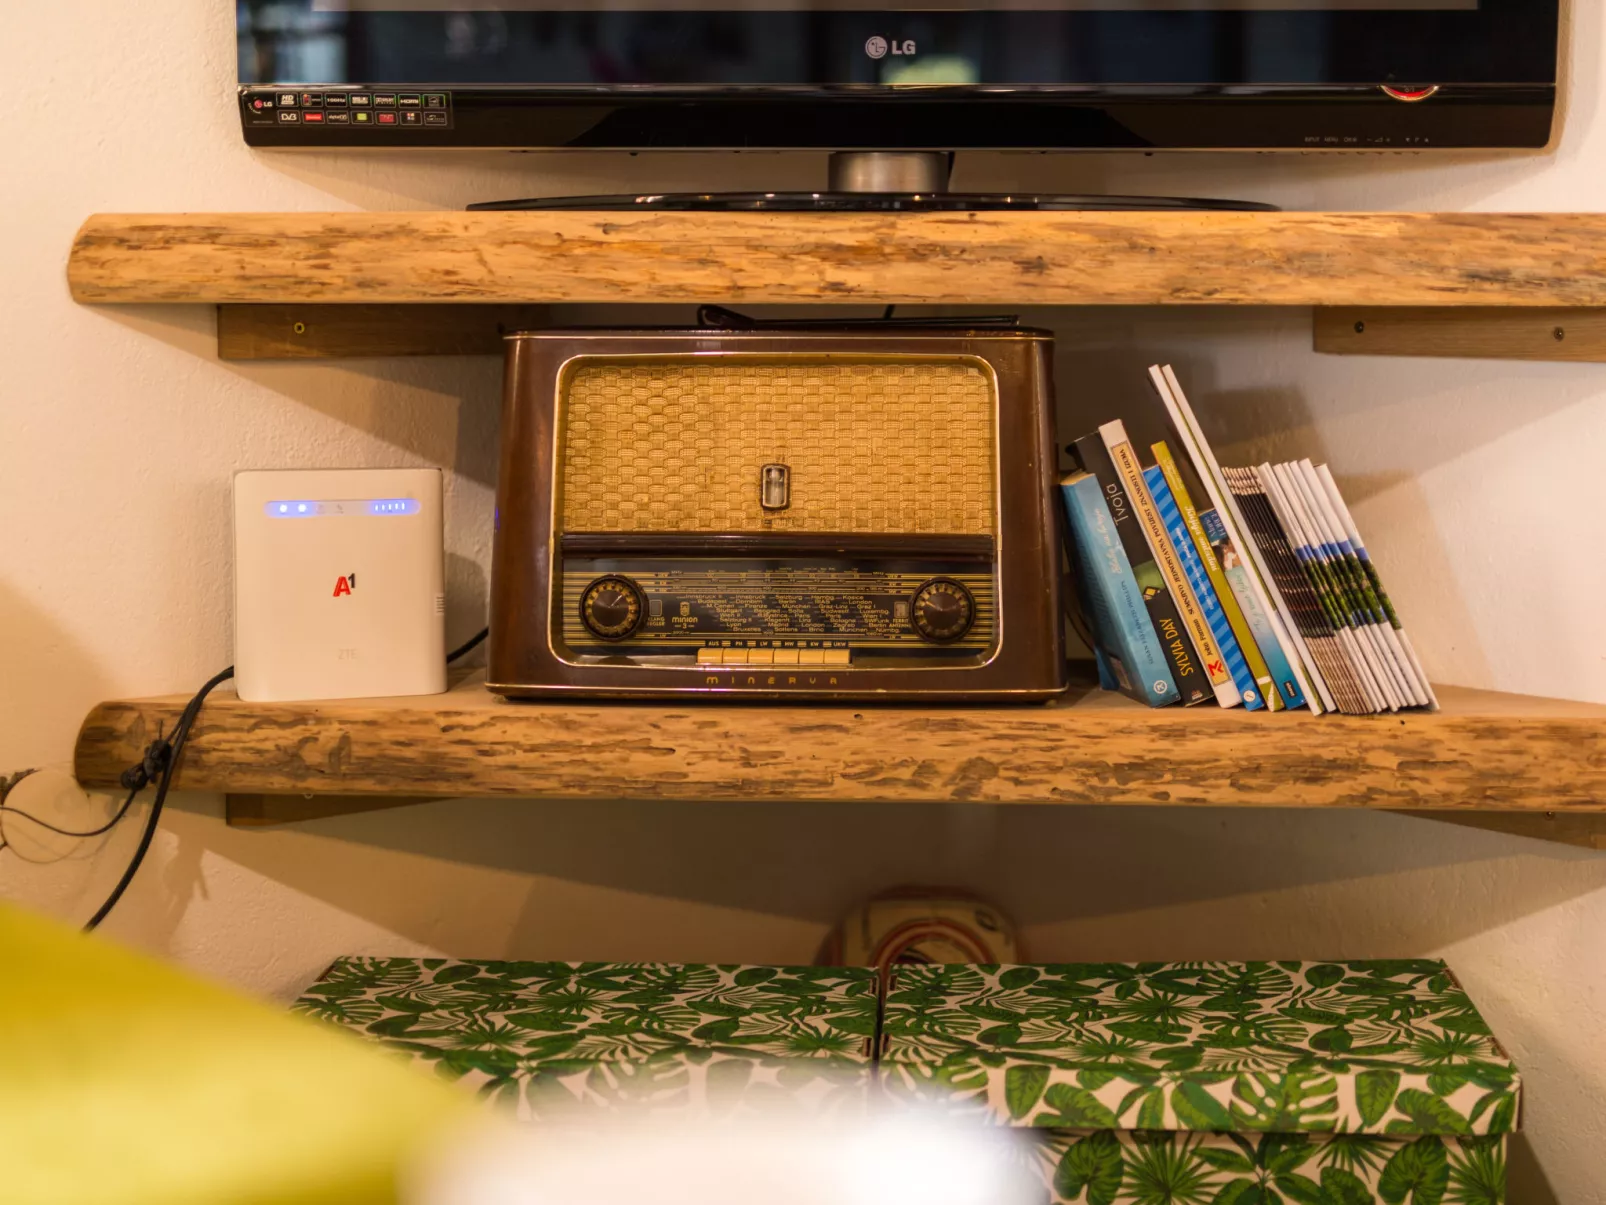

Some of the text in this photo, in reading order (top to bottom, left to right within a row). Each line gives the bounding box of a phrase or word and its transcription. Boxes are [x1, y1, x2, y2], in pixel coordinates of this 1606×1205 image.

[892, 40, 916, 54] LG
[1120, 448, 1131, 469] IZUMA
[1130, 473, 1147, 506] ZNANOSTI
[1106, 483, 1130, 526] Tvoja
[1145, 507, 1160, 537] POVIJEST
[1158, 537, 1180, 583] JEDNOSTAVNA
[333, 573, 355, 597] A1
[338, 650, 357, 660] ZTE
[1159, 618, 1194, 676] SYLVIA DAY
[1202, 641, 1211, 656] John
[706, 676, 837, 684] MINERVA
